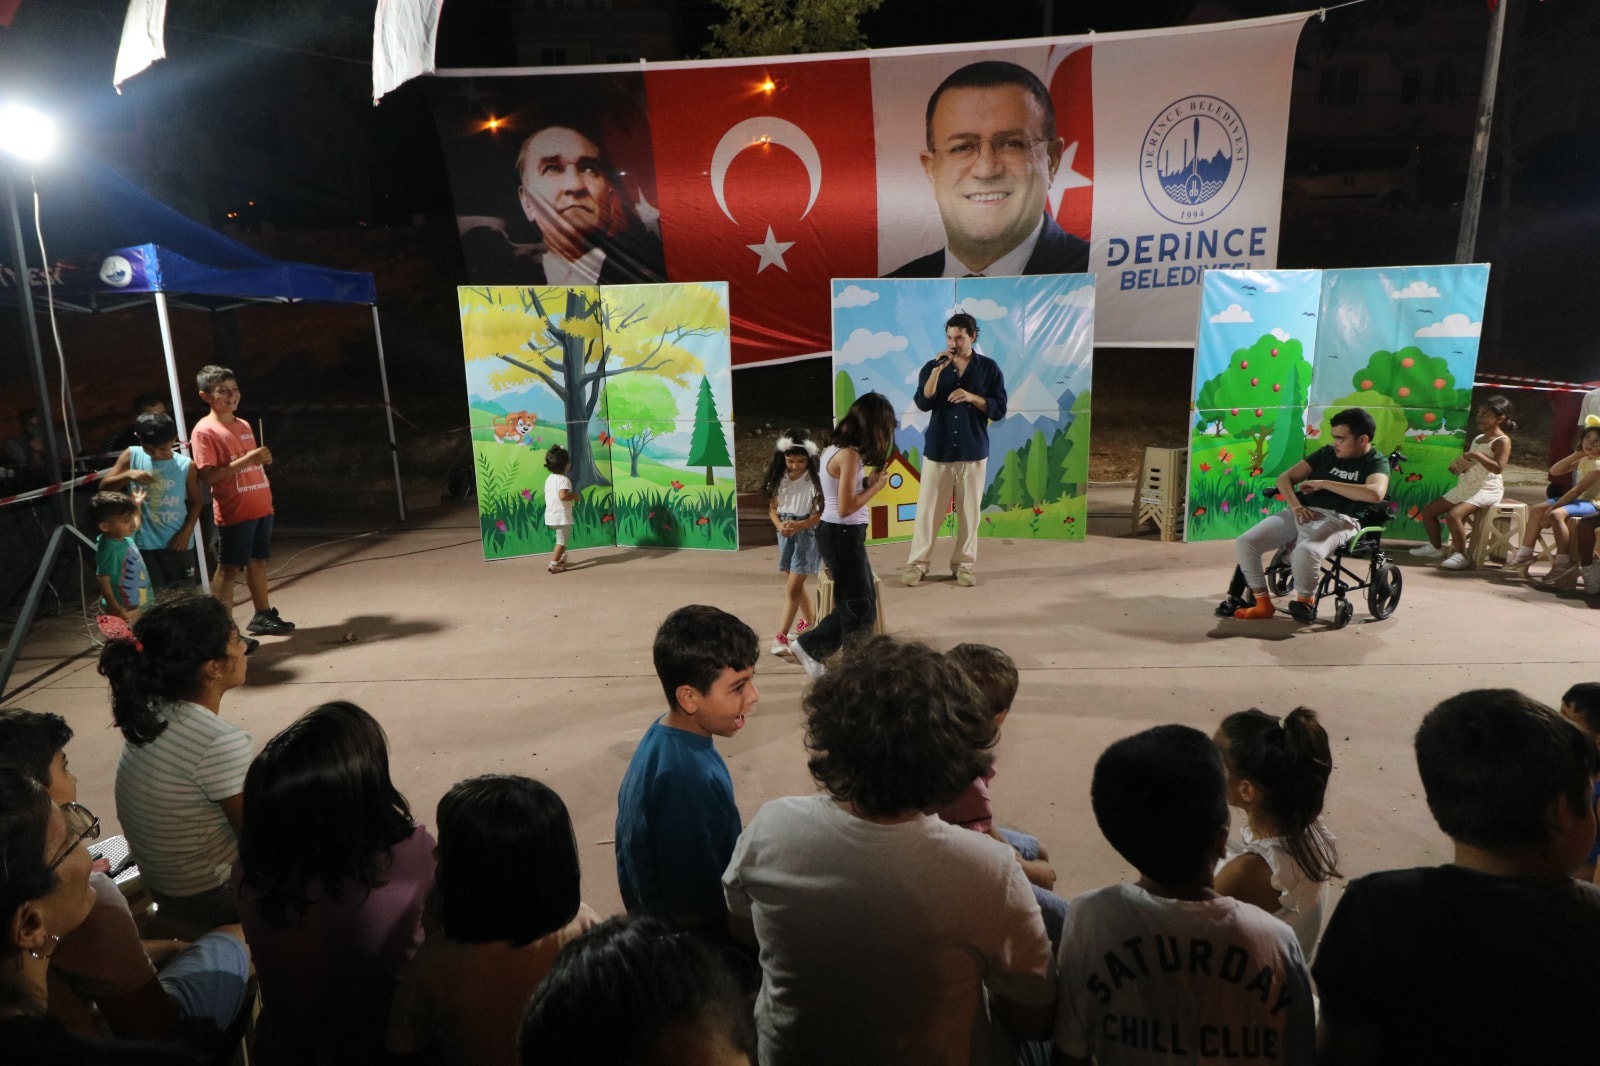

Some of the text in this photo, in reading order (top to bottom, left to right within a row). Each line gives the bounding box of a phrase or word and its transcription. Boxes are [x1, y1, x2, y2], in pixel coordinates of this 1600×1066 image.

[1145, 101, 1245, 169] DERİNCE BELEDİYESİ
[1180, 209, 1205, 219] 1994
[1107, 227, 1267, 266] DERİNCE
[1120, 262, 1252, 290] BELEDİ
[1329, 467, 1359, 481] mavi
[1087, 934, 1291, 1016] SATURDAY
[1102, 1013, 1188, 1056] CHILL
